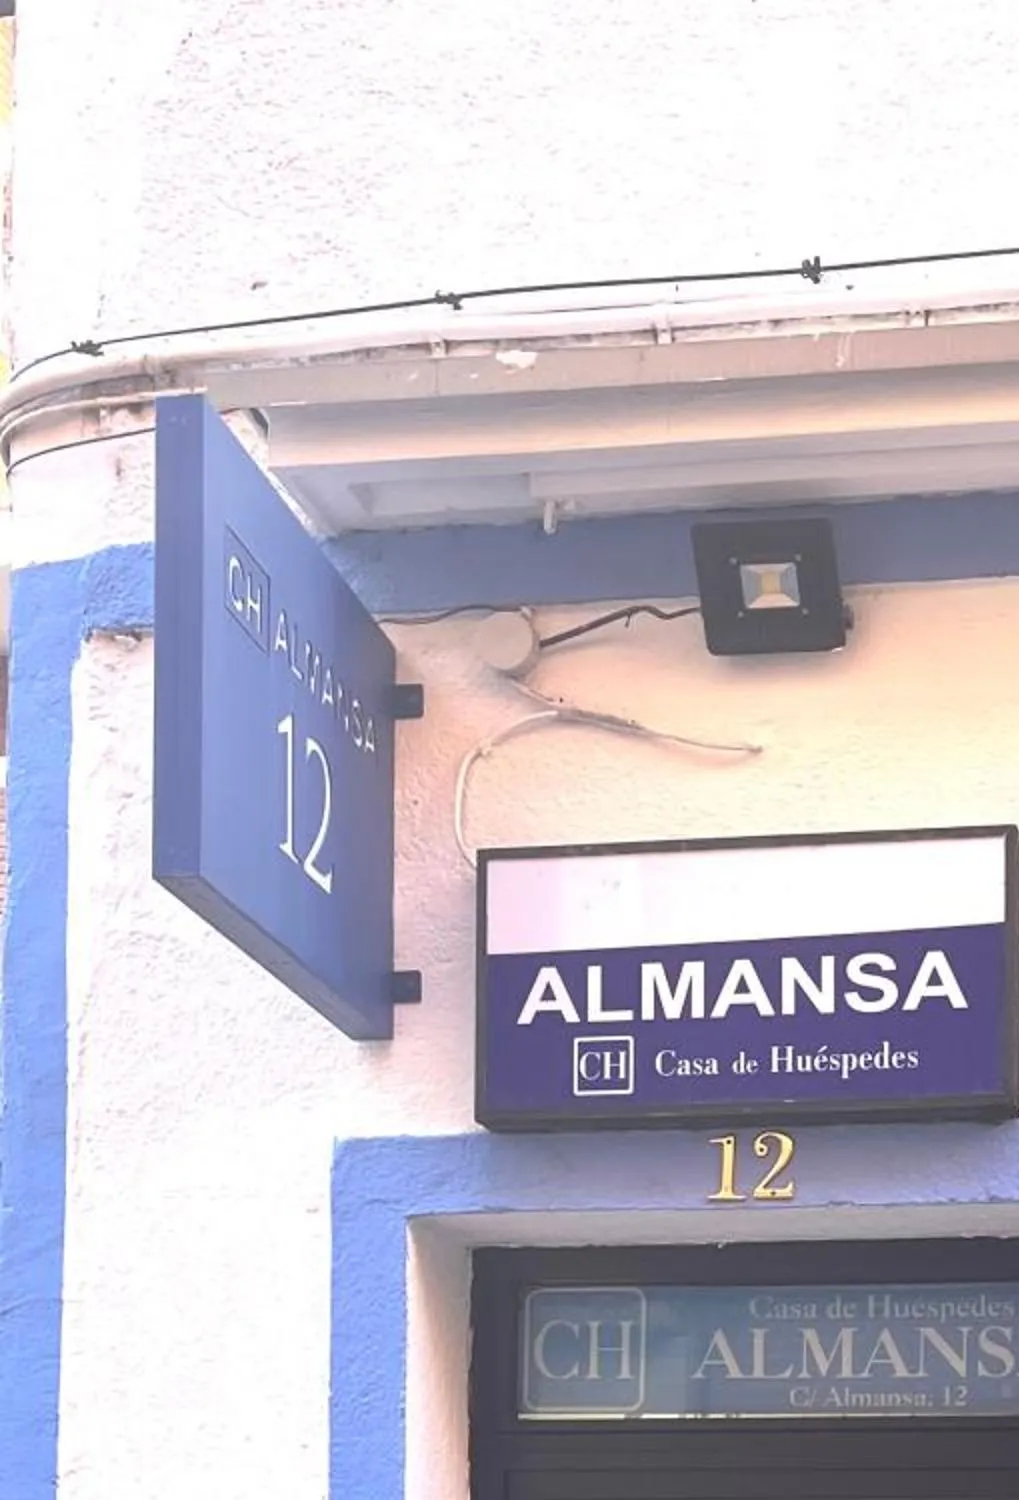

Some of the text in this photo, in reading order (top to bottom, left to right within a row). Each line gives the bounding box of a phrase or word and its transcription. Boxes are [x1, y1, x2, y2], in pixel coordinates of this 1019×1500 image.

[226, 555, 264, 634] CH
[276, 712, 333, 894] 12
[516, 950, 969, 1025] ALMANSA
[579, 1050, 627, 1080] CH
[655, 1041, 919, 1079] Casa de Huéspedes
[708, 1130, 795, 1201] 12
[749, 1296, 818, 1320] Casa
[826, 1296, 857, 1320] de
[533, 1319, 635, 1380] CH
[789, 1386, 817, 1408] C/
[942, 1385, 969, 1407] 12
